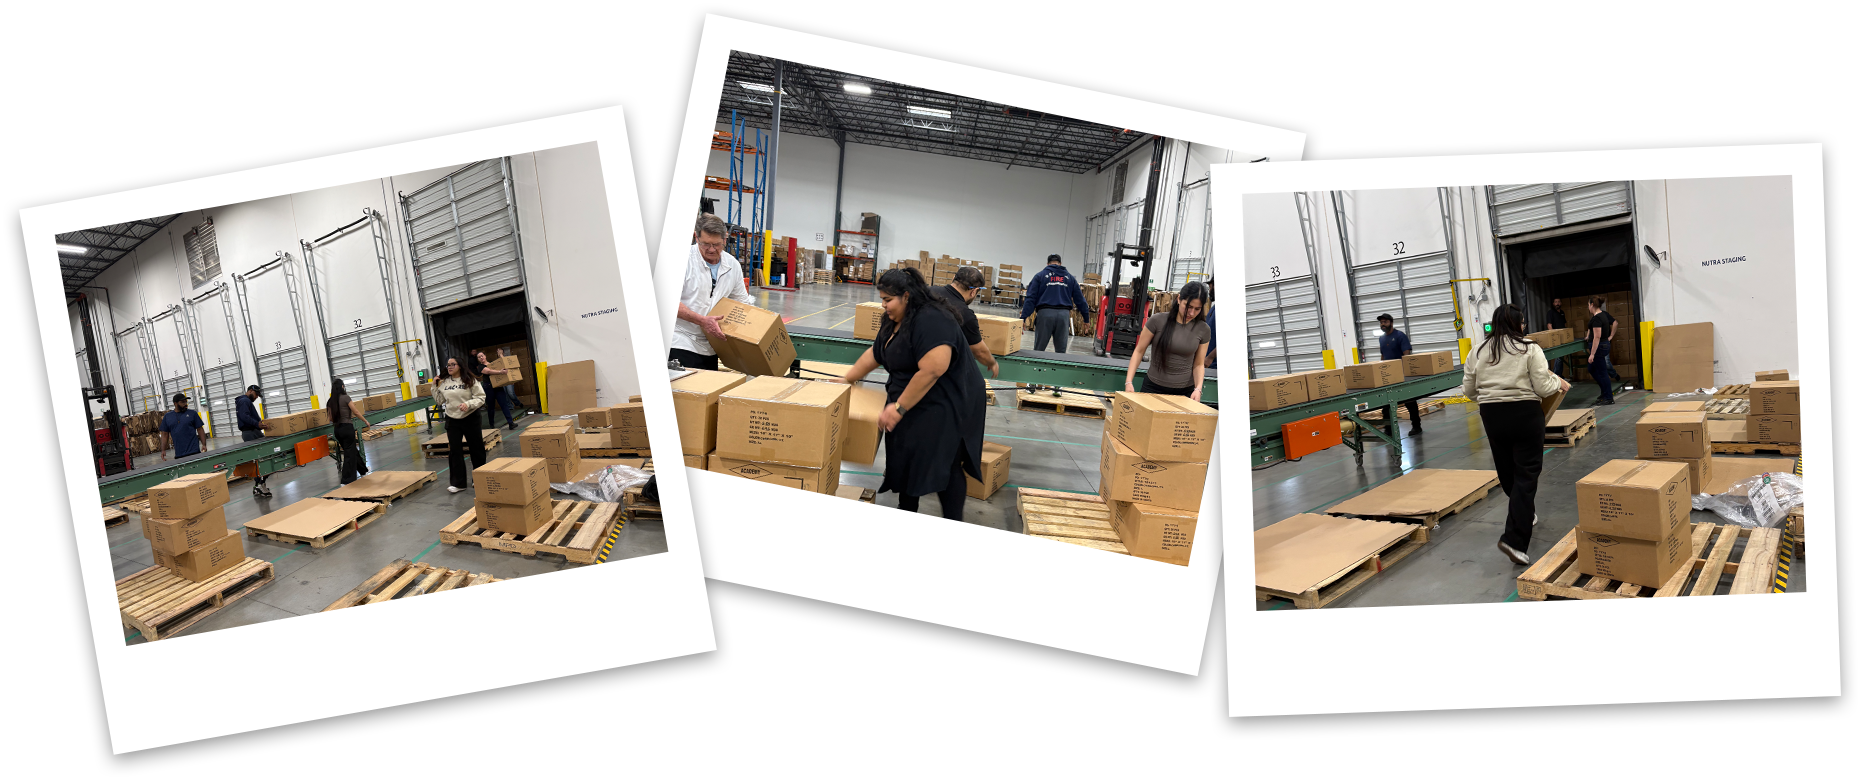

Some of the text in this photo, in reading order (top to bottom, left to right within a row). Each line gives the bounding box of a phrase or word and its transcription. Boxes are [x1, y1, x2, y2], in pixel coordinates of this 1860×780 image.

[1392, 241, 1405, 255] 32
[1722, 256, 1746, 264] STAGING
[1270, 266, 1280, 278] 33
[353, 318, 363, 329] 32
